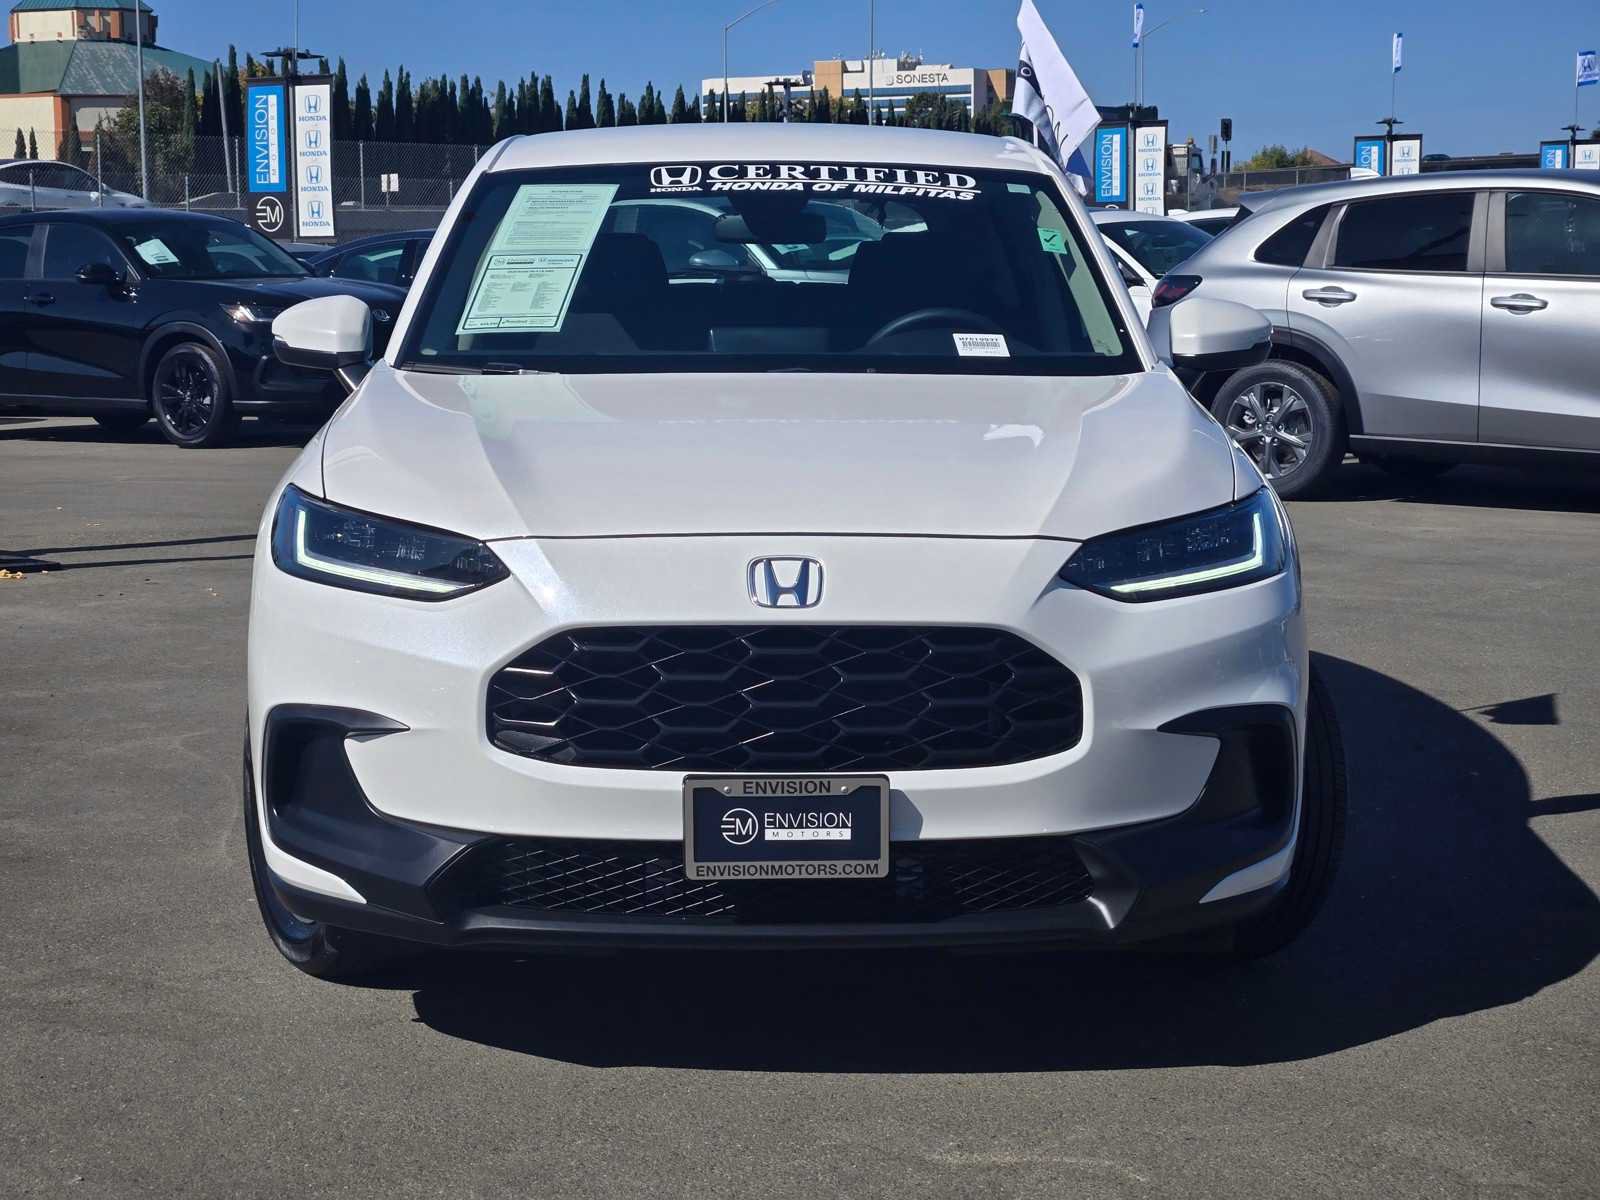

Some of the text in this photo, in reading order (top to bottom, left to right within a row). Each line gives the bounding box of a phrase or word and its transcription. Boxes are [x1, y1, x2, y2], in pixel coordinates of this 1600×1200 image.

[895, 73, 949, 84] SONESTA
[255, 95, 269, 184] ENVISION
[1102, 134, 1113, 197] ENVISION
[709, 164, 977, 189] CERTIFIED
[711, 182, 976, 201] HONDA OF MILPITAS
[743, 780, 831, 795] ENVISION
[764, 812, 852, 828] ENVISION
[695, 863, 879, 877] ENVISIONMOTORS.COM
